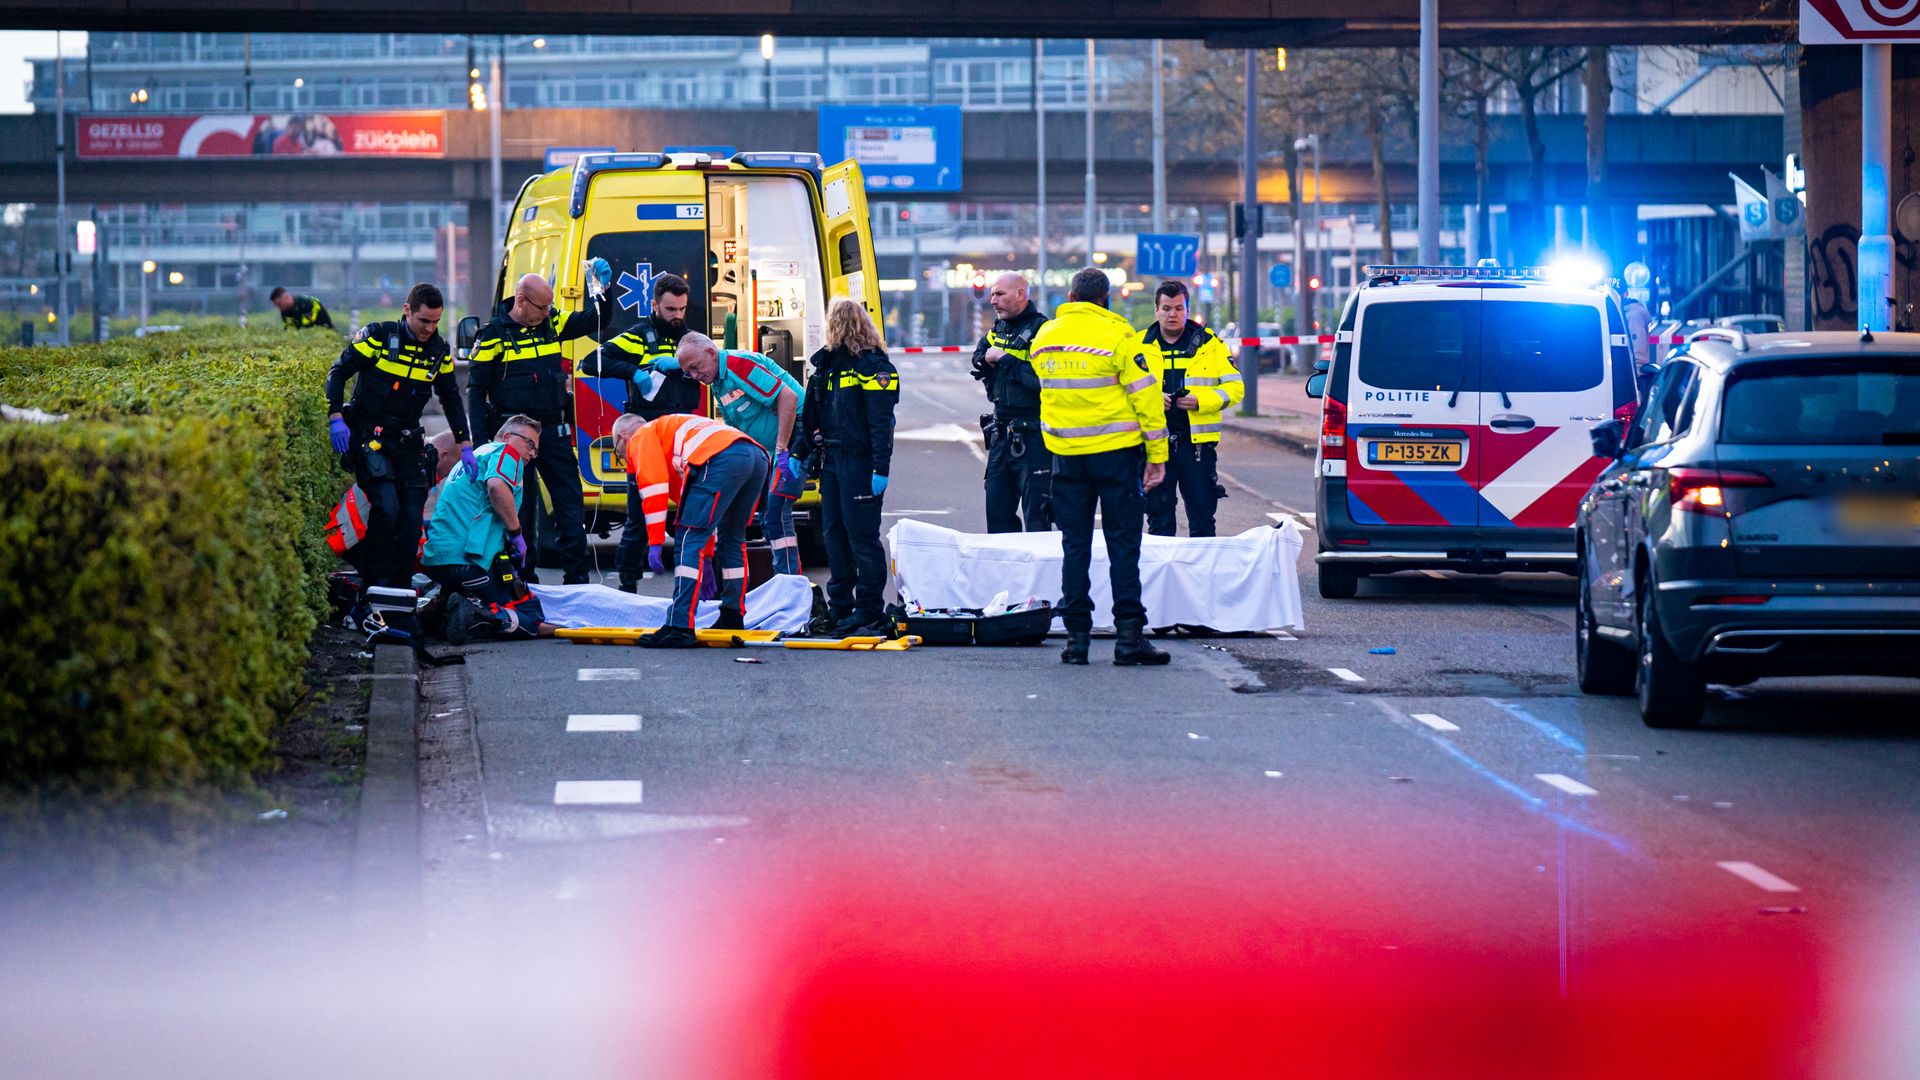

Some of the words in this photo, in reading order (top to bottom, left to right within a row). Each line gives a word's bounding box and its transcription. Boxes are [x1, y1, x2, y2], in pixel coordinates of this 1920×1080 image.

[89, 123, 164, 137] GEZELLIG
[353, 129, 438, 153] zuidplein
[1365, 392, 1430, 402] POLITIE
[1385, 445, 1450, 460] P-135-ZK
